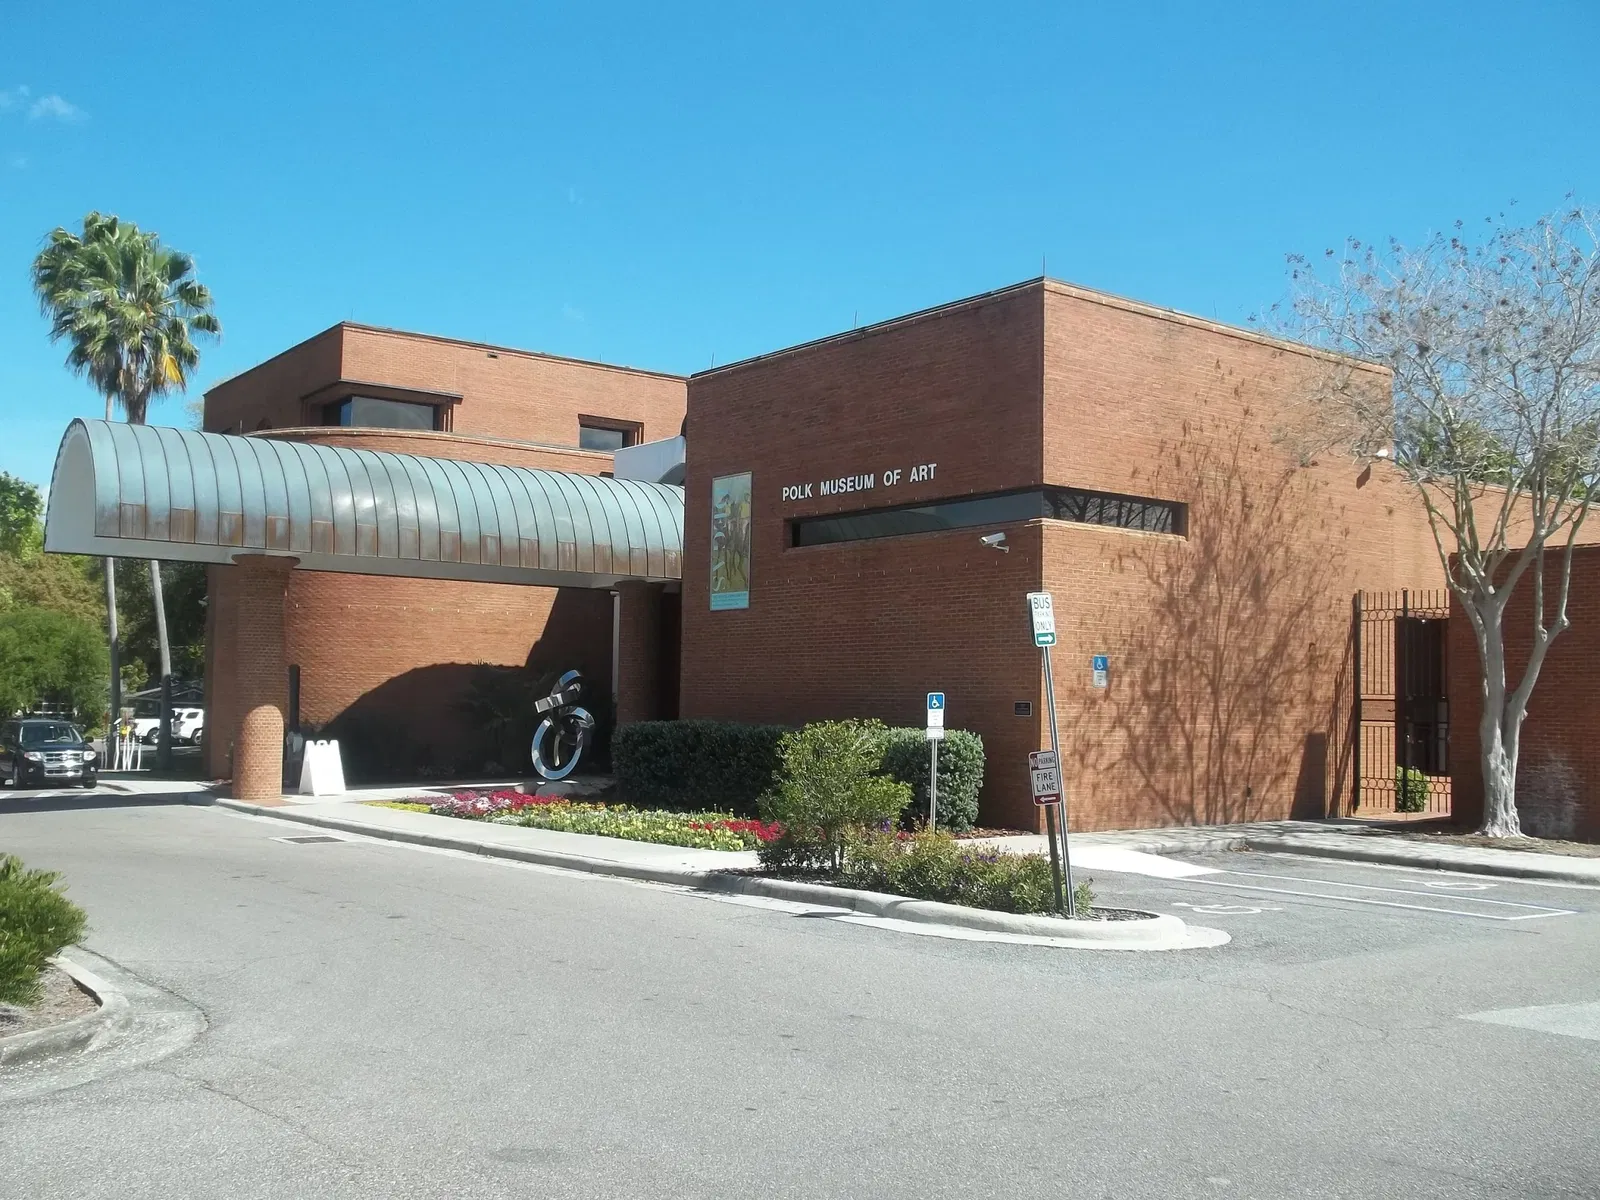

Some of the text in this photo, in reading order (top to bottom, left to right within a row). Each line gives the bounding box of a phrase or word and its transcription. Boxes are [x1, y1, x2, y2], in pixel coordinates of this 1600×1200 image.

[782, 463, 937, 502] POLK MUSEUM OF ART
[1033, 597, 1050, 609] BUS
[1035, 620, 1052, 631] ONLY
[1030, 756, 1055, 768] NO PARKING
[1036, 771, 1053, 782] FIRE
[1036, 782, 1056, 792] LANE
